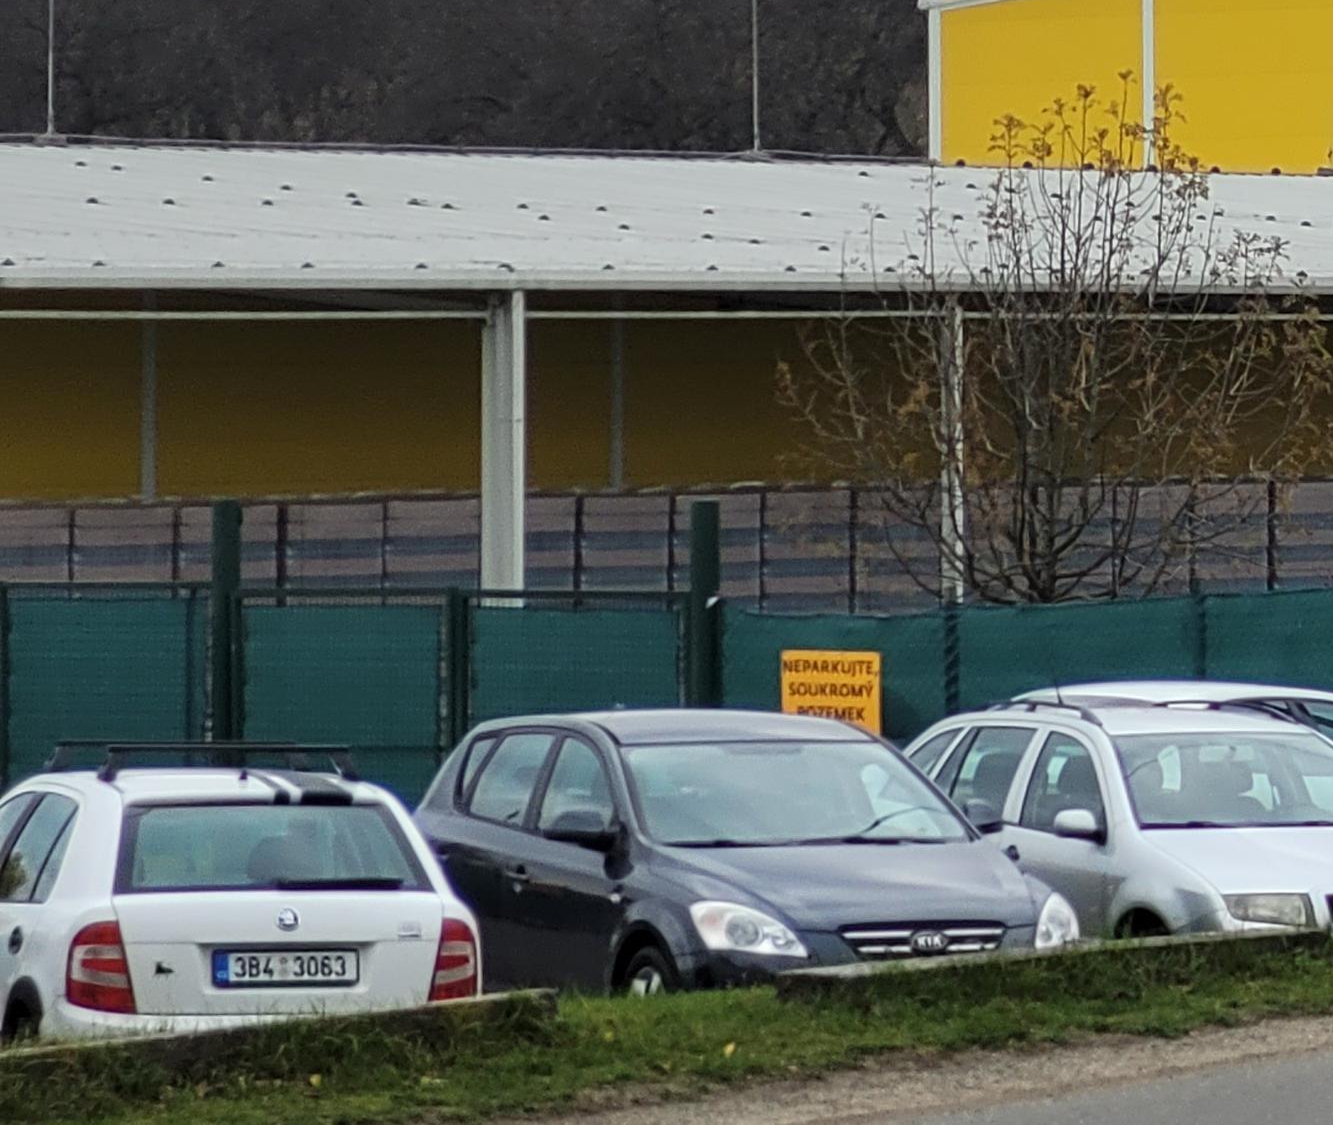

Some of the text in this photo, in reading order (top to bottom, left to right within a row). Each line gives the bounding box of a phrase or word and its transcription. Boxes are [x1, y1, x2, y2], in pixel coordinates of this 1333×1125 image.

[787, 680, 874, 698] SOUKROMÝ
[233, 955, 275, 979] 3B4
[292, 954, 347, 979] 3063
